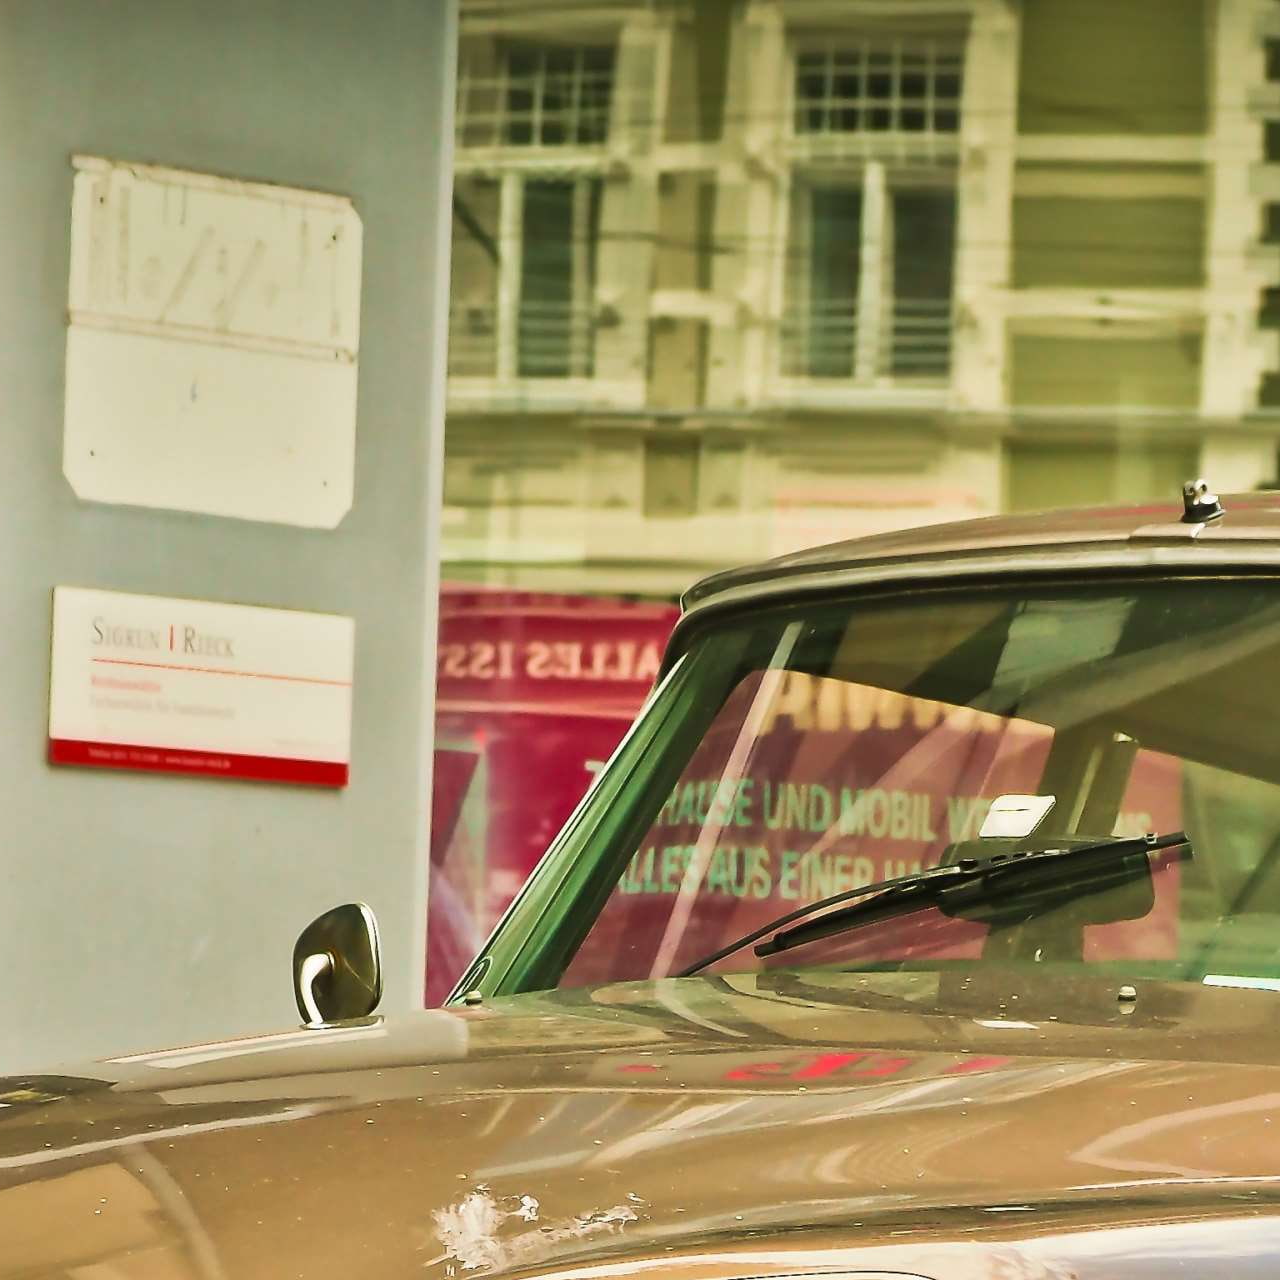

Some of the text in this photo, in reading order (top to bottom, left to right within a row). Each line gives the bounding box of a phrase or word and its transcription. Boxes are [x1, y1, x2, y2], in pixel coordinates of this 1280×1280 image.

[763, 782, 832, 833] UND
[839, 786, 937, 842] MOBIL
[619, 845, 699, 895] LLES
[707, 845, 771, 899] AUS
